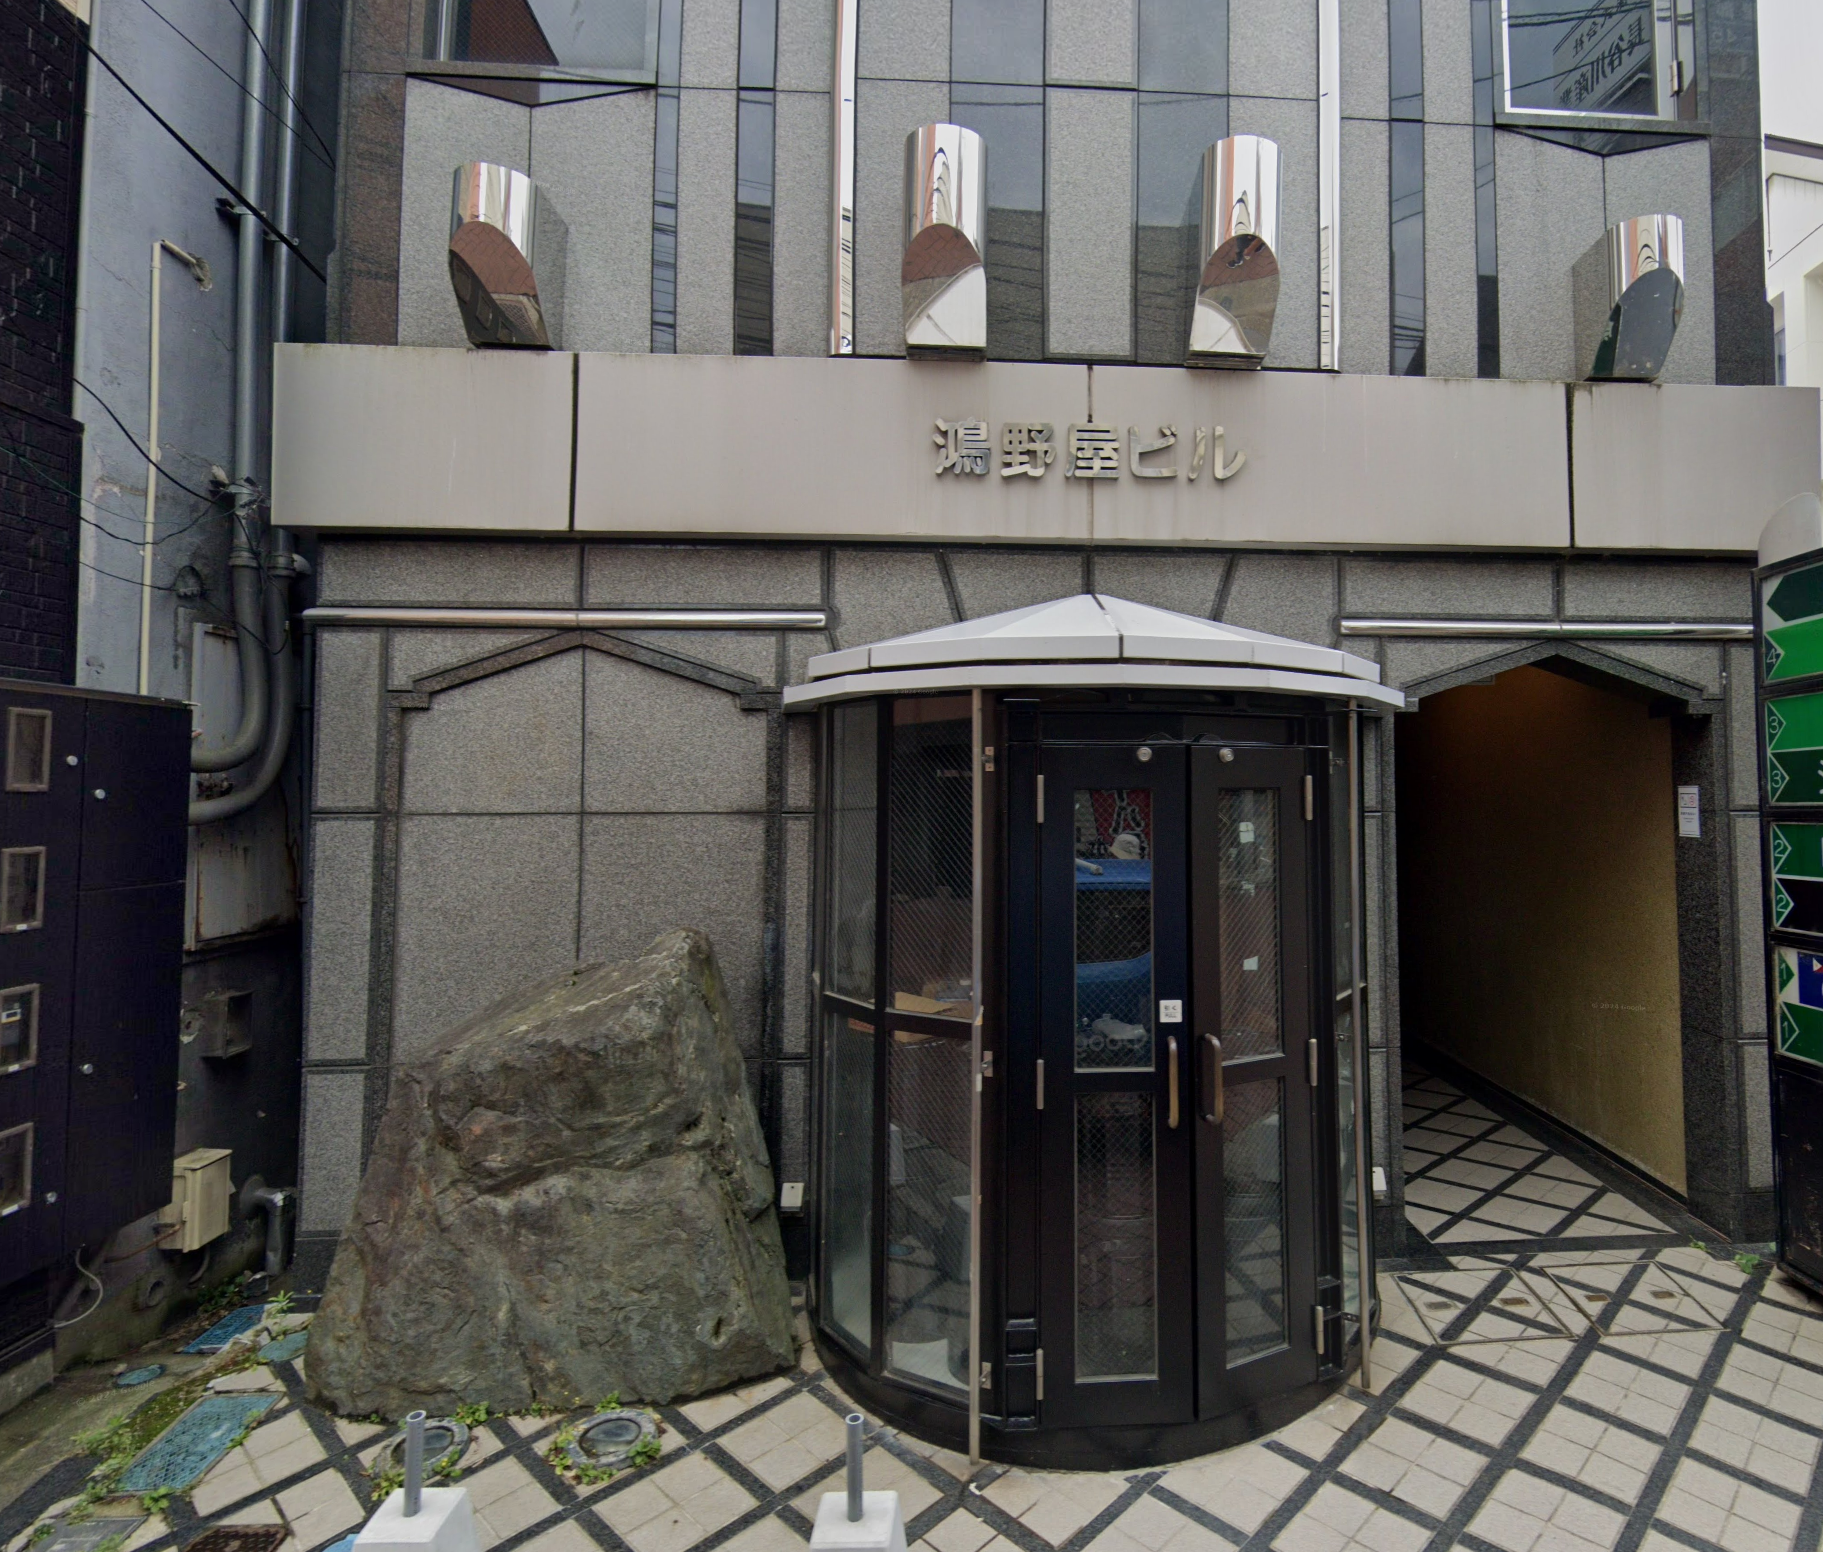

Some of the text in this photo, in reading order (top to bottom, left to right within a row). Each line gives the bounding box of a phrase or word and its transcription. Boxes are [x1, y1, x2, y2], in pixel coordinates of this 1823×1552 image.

[933, 417, 1247, 481] 鴻野屋ビル
[1766, 647, 1777, 665] 4
[1769, 715, 1779, 734] 3
[1771, 770, 1781, 788] 3
[1774, 839, 1785, 857] 2
[1776, 894, 1787, 912] 2
[1780, 962, 1787, 980] 1
[1782, 1020, 1789, 1039] 1
